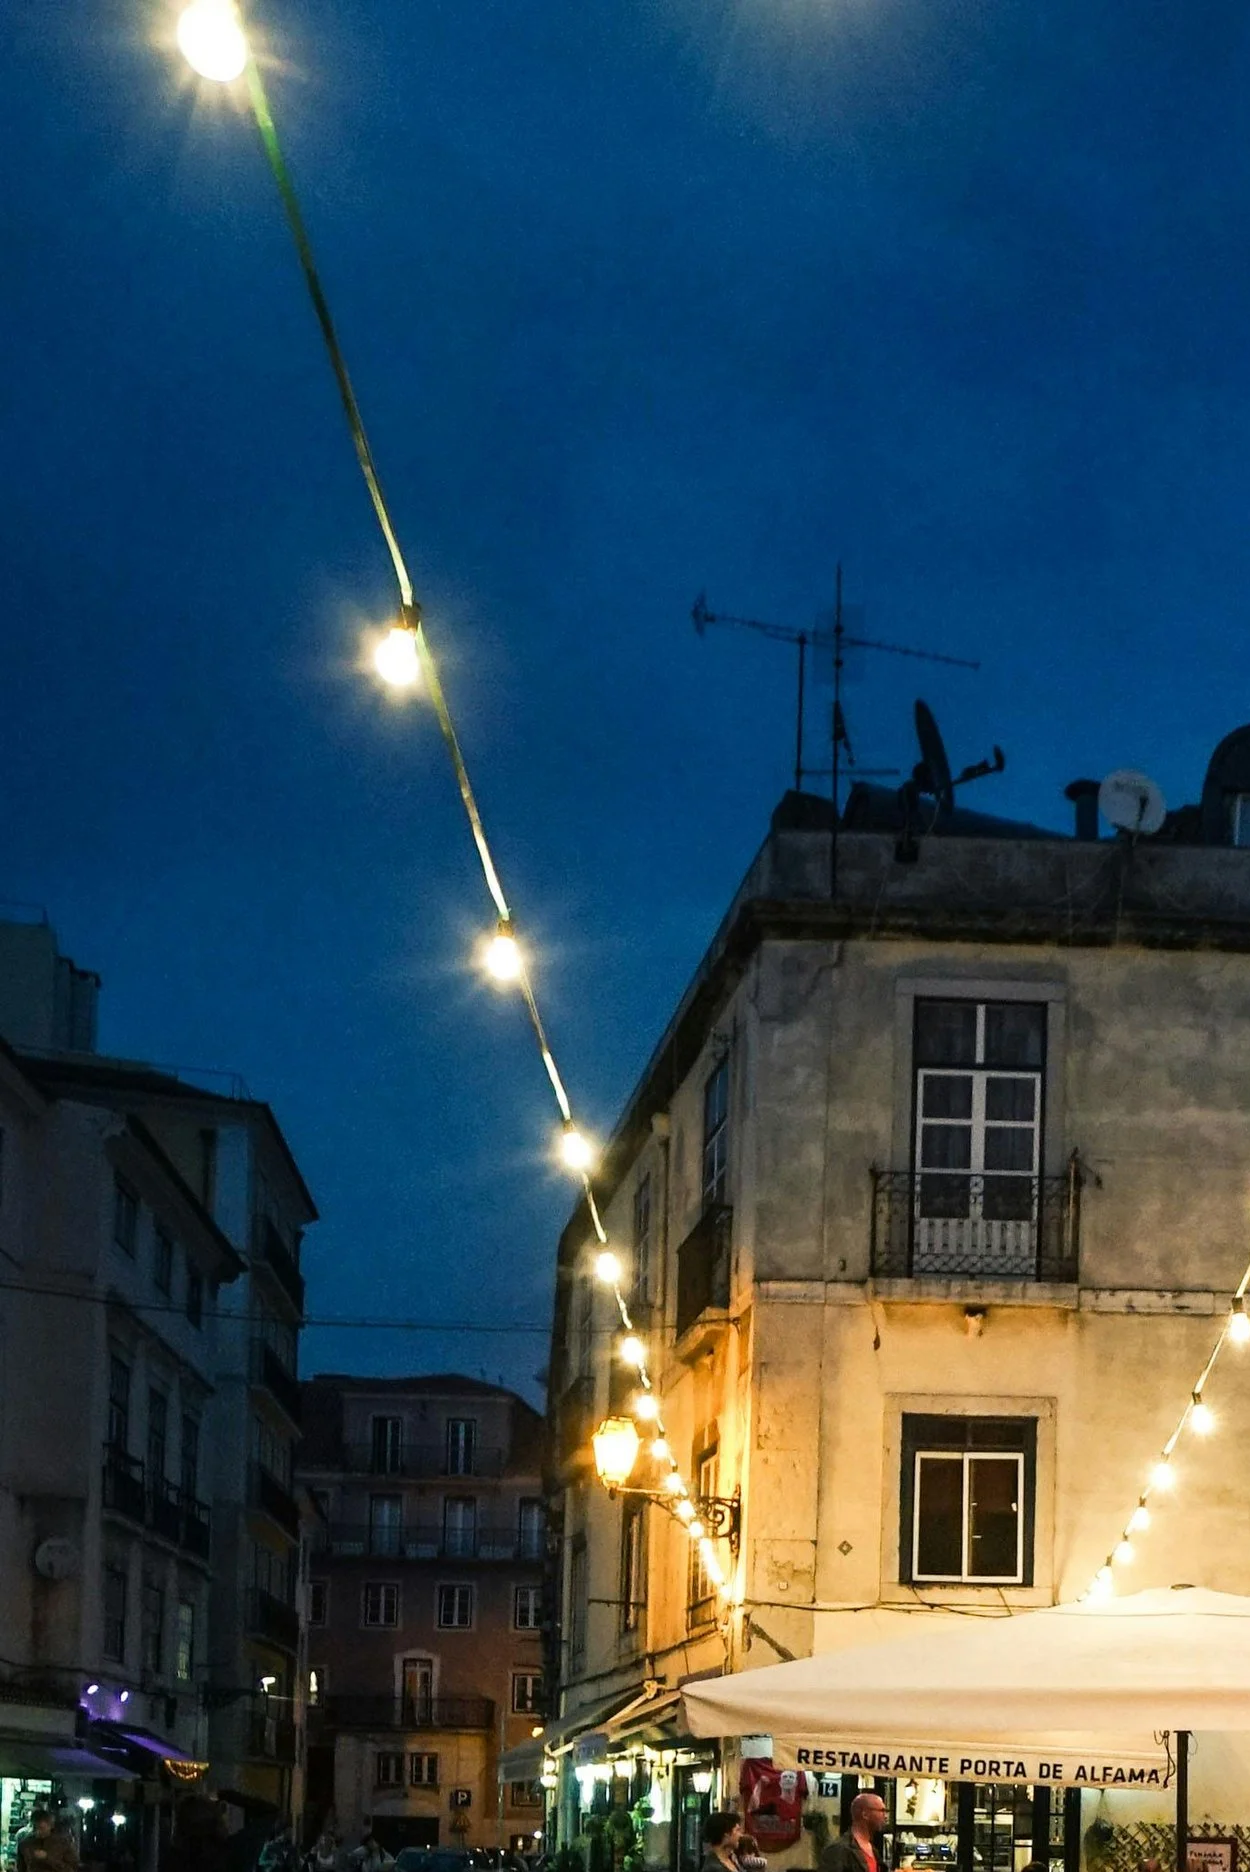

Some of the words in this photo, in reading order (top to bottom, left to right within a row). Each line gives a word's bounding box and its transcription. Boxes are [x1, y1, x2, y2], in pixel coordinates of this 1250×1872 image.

[797, 1748, 950, 1774] RESTAURANTE
[959, 1758, 1027, 1778] PORTA
[1038, 1762, 1063, 1780] DE
[1074, 1765, 1160, 1784] ALFAMA
[458, 1791, 468, 1805] P
